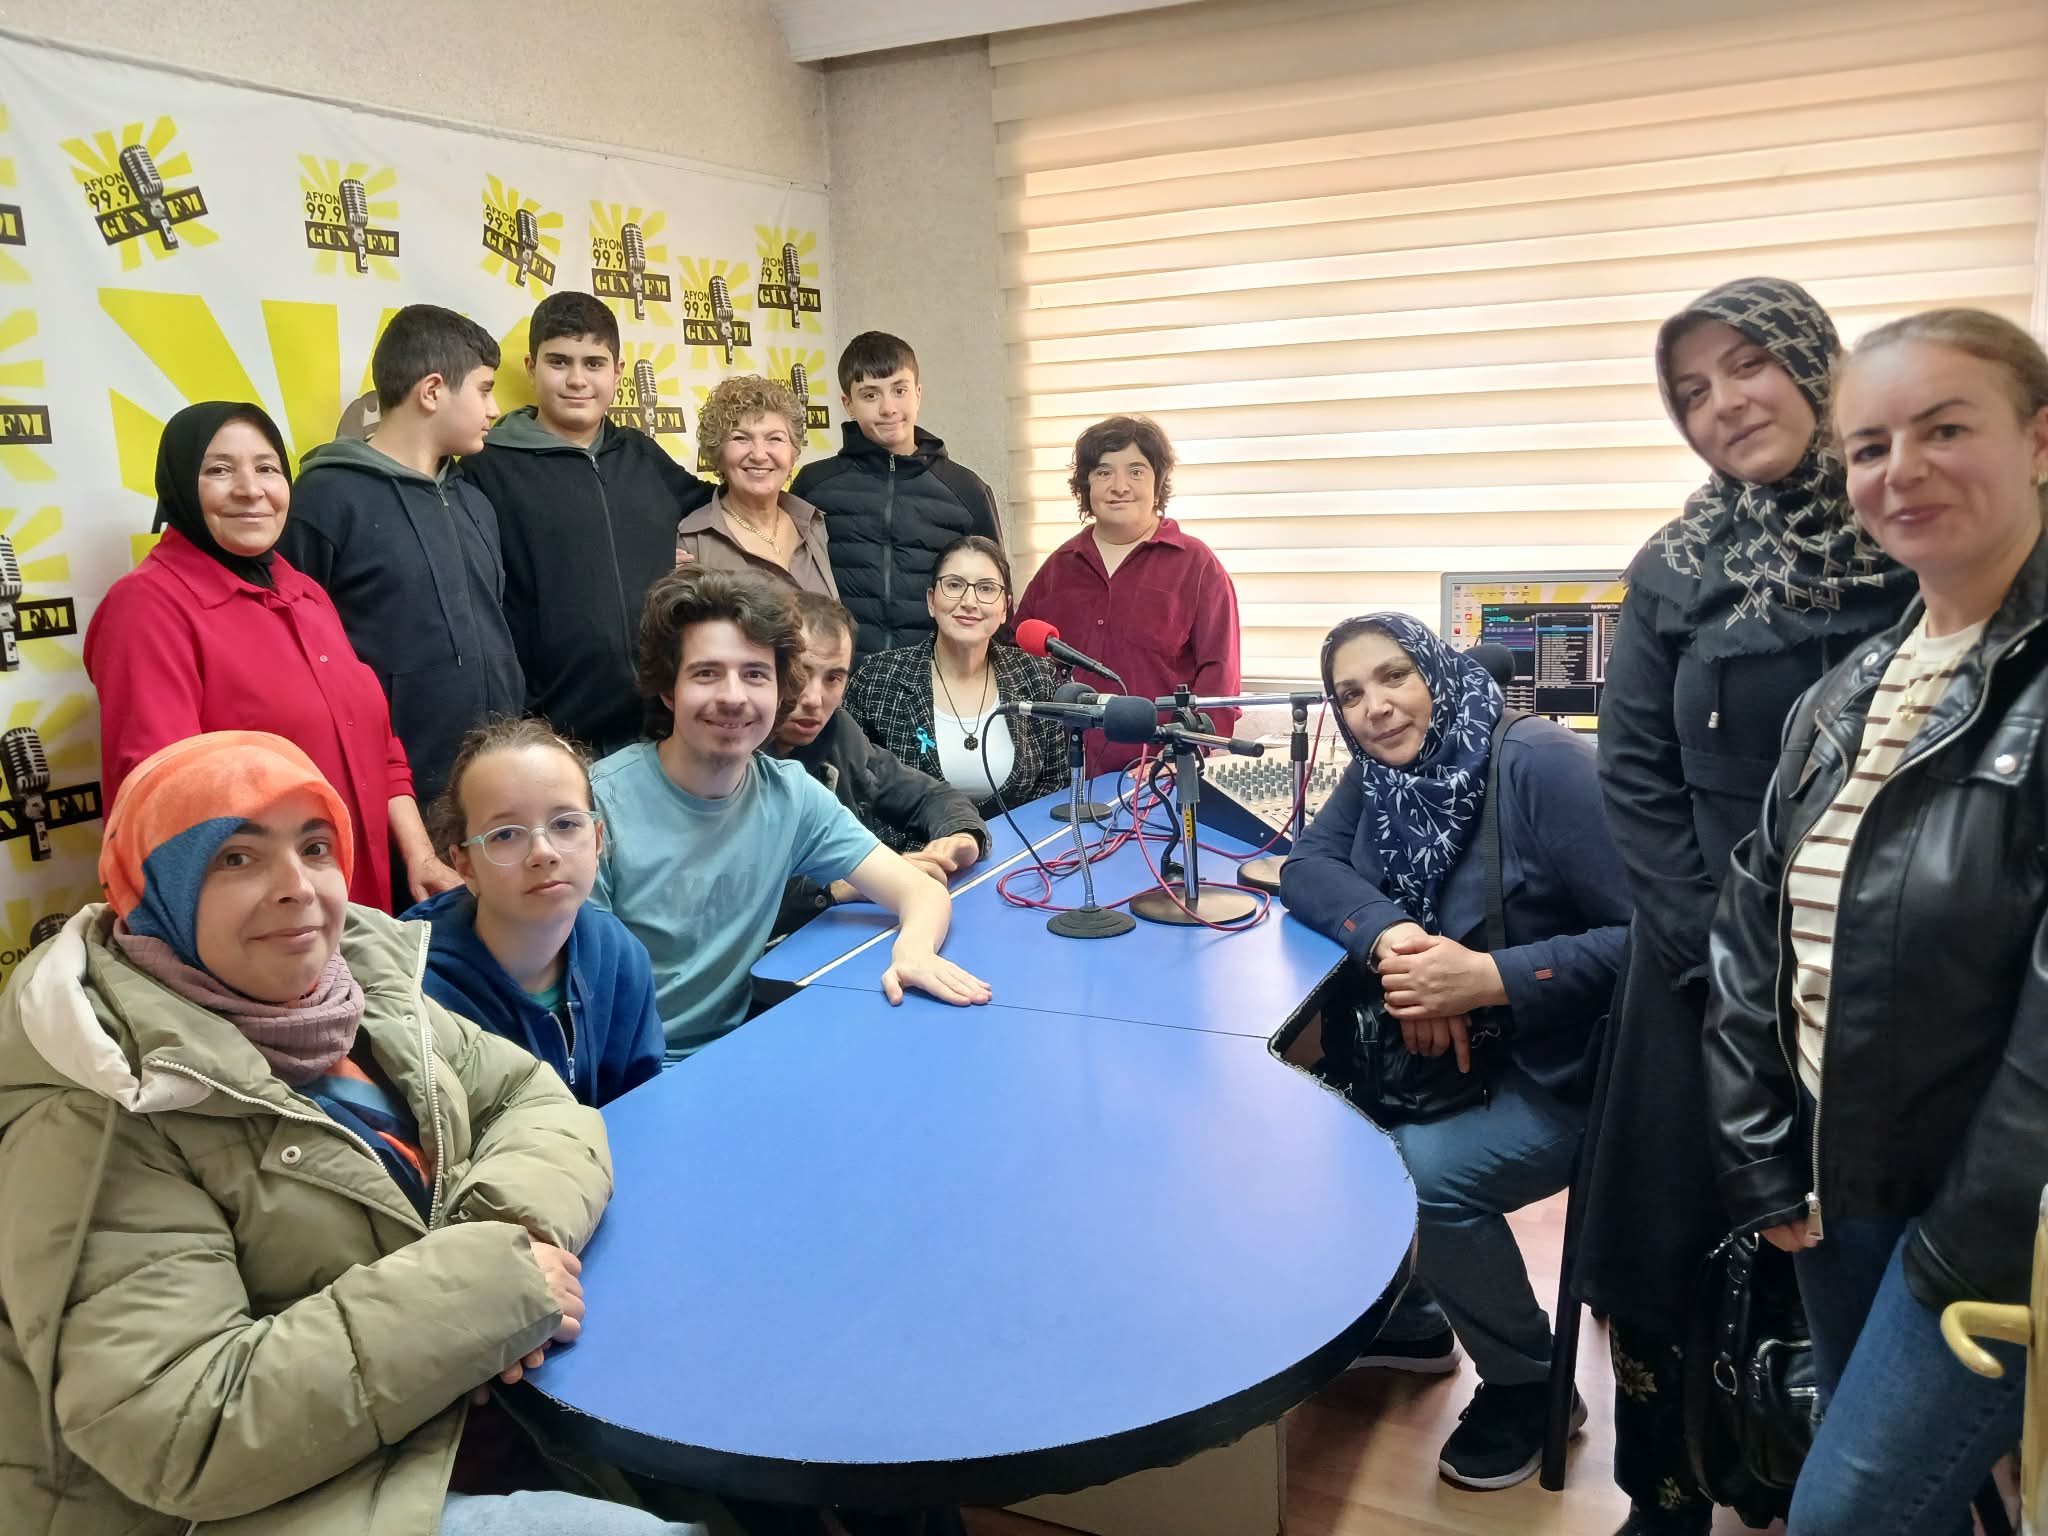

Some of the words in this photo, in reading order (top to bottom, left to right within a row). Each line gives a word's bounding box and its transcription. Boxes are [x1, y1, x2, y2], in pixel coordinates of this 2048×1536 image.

[83, 171, 126, 193] AFYON
[88, 184, 130, 213] 99.9
[165, 193, 202, 219] FM
[305, 191, 341, 206] AFYON
[306, 202, 342, 223] 99.9
[485, 204, 516, 226] AFYON
[485, 211, 516, 238] 99.9
[308, 225, 350, 247] GÜN
[366, 234, 395, 252] FM
[592, 237, 622, 251] AFYON
[530, 257, 553, 281] FM
[593, 248, 624, 269] 99.9
[595, 271, 630, 293] GÜN
[644, 279, 668, 297] FM
[683, 290, 710, 302] AFYON
[800, 292, 818, 308] FM
[684, 300, 711, 319] 99.9
[685, 322, 719, 341] GÜN
[656, 412, 681, 428] FM
[807, 410, 827, 425] FM
[19, 606, 70, 633] FM
[50, 791, 97, 821] FM
